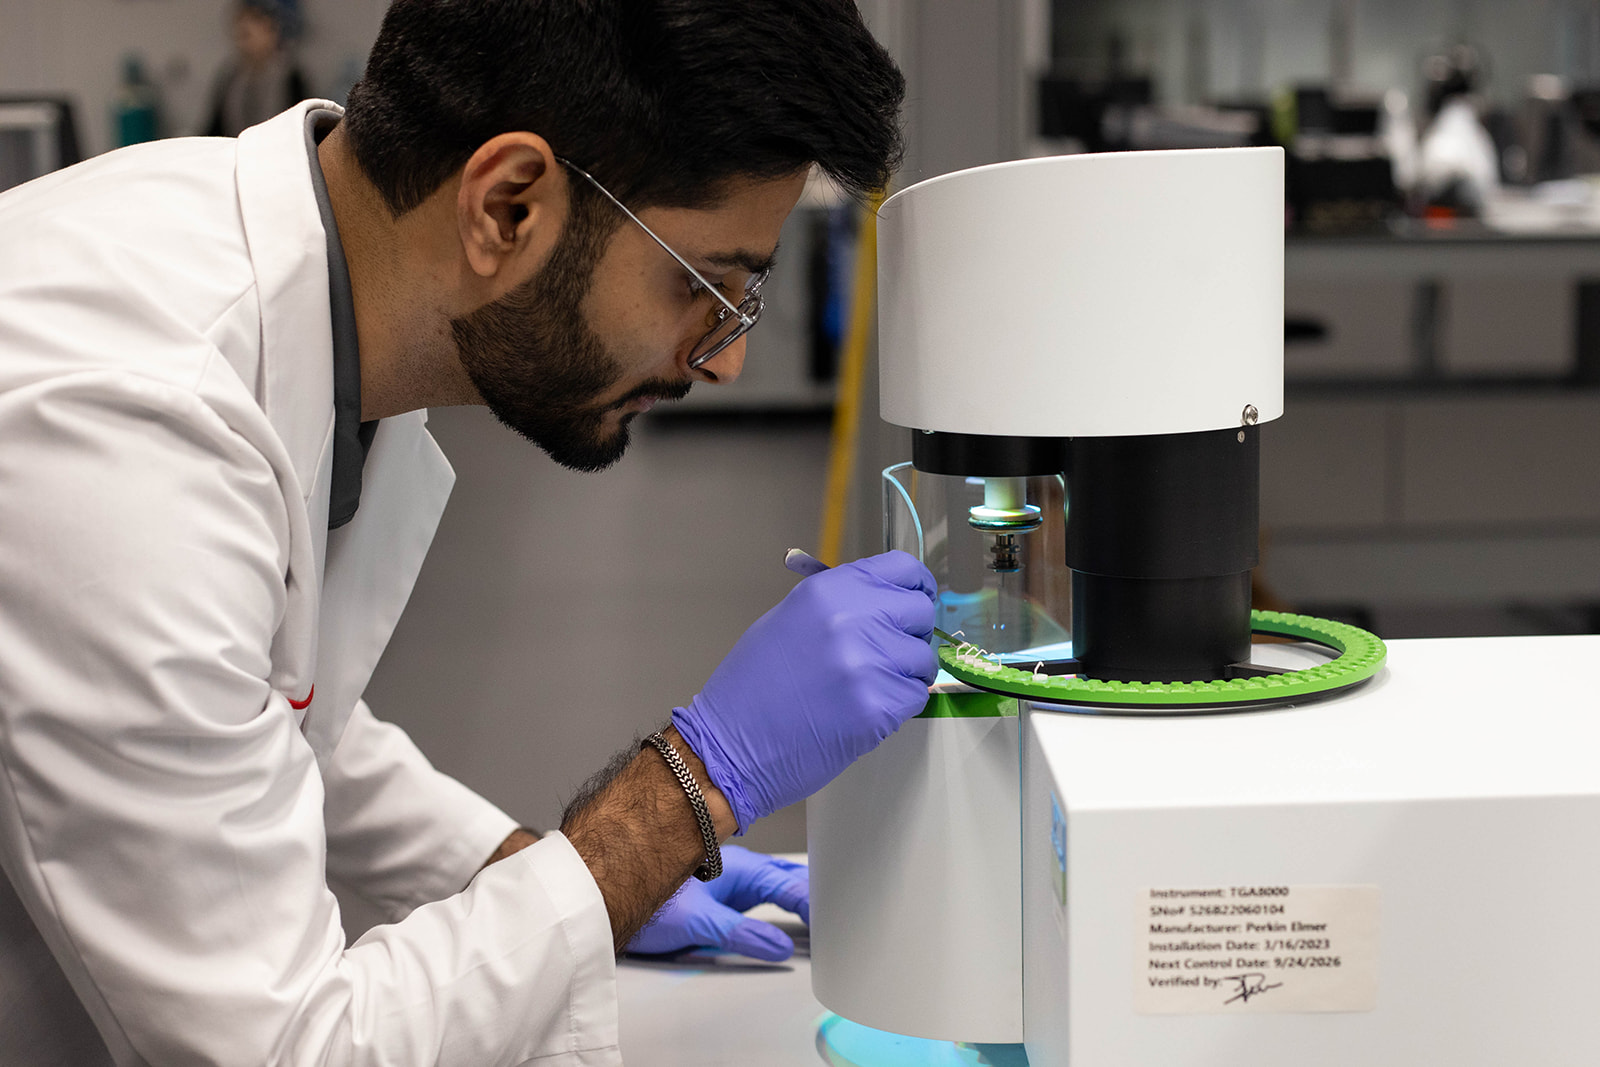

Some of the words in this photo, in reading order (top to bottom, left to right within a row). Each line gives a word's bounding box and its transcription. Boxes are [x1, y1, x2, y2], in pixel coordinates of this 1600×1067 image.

[1150, 888, 1226, 898] Instrument:
[1231, 887, 1290, 897] TGA8000
[1150, 905, 1185, 916] SNo#
[1149, 922, 1242, 933] Manufacturer:
[1246, 921, 1288, 932] Perkin
[1291, 921, 1328, 932] Elmer
[1149, 940, 1222, 951] Installation
[1226, 940, 1260, 950] Date:
[1265, 938, 1330, 950] 3/16/2023
[1148, 959, 1181, 969] Next
[1184, 957, 1233, 969] Control
[1236, 958, 1271, 968] Date:
[1274, 956, 1341, 968] 9/24/2026
[1148, 976, 1200, 987] Verified
